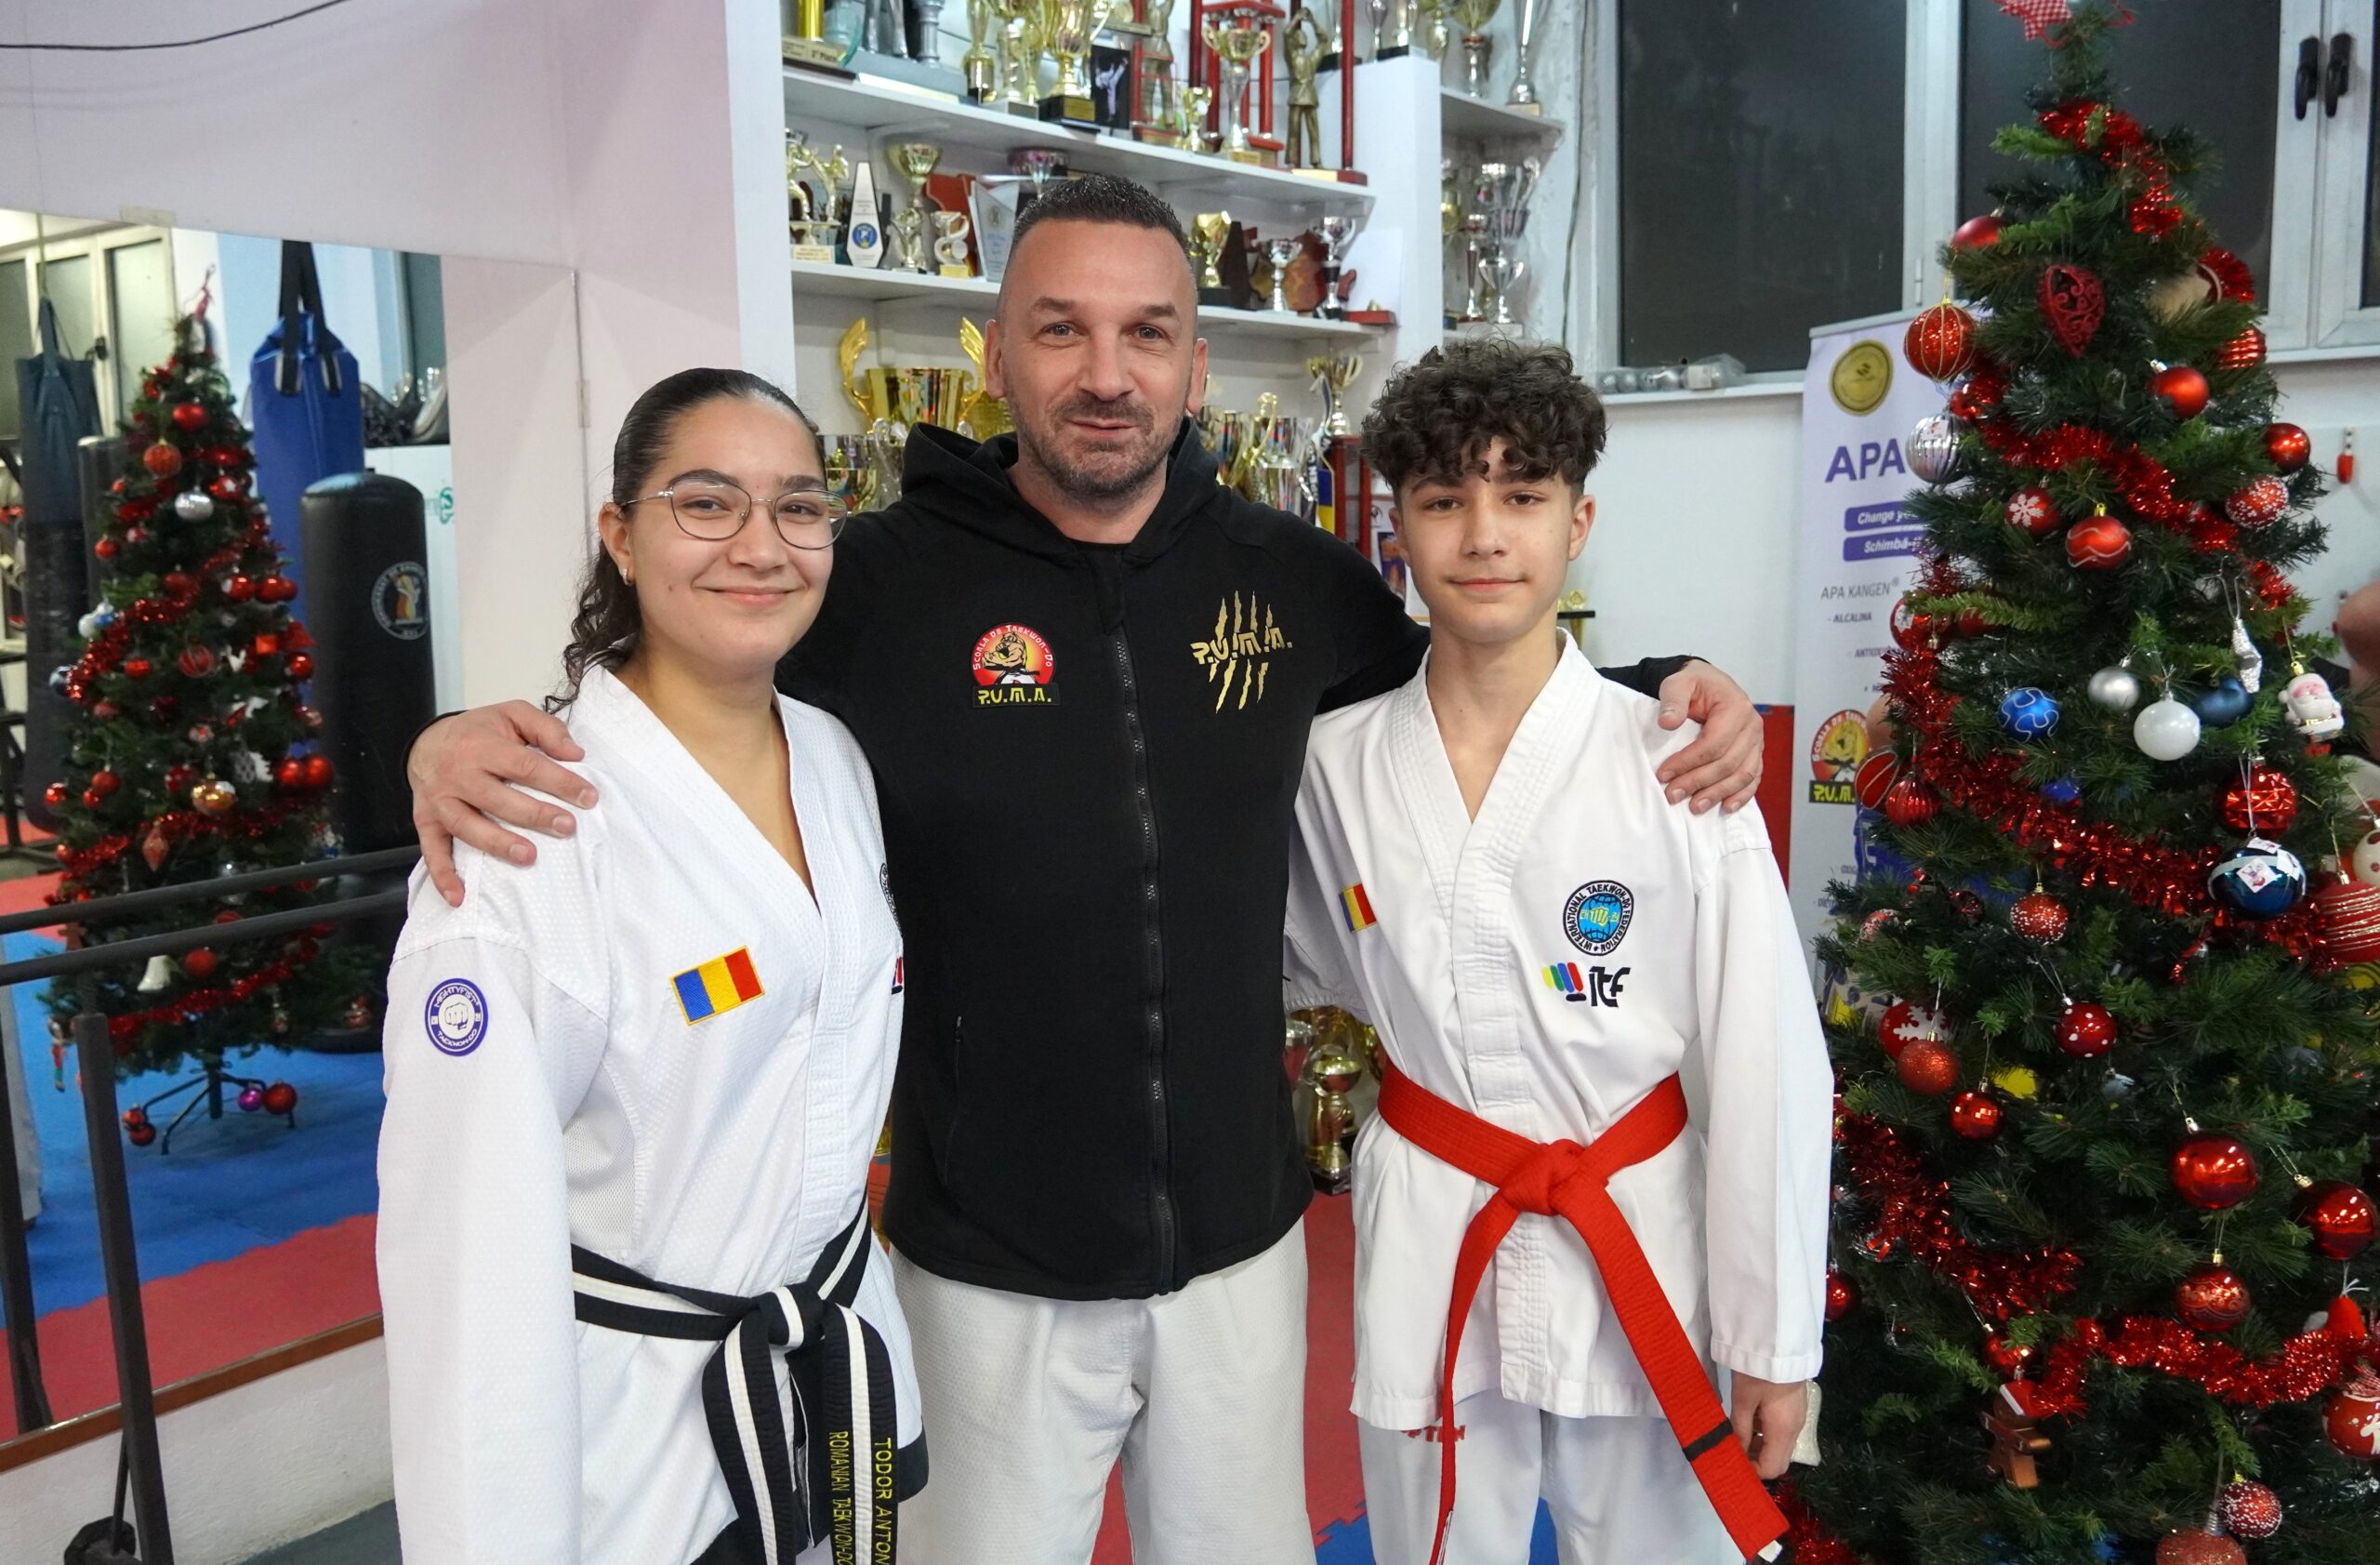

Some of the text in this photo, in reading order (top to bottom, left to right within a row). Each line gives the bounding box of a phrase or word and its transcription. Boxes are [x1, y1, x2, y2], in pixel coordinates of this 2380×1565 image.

[1824, 438, 1906, 483] APA
[1858, 511, 1895, 524] Change
[1821, 586, 1844, 600] APA
[1190, 627, 1293, 665] P.U.M.A.
[977, 687, 1052, 705] P.U.M.A.
[1813, 784, 1856, 803] P.U.M.
[1567, 883, 1631, 953] INTERNATIONAL TAEKWON-DO FEDERATION
[828, 1430, 851, 1492] ROMANIAN
[874, 1437, 892, 1500] TODOR
